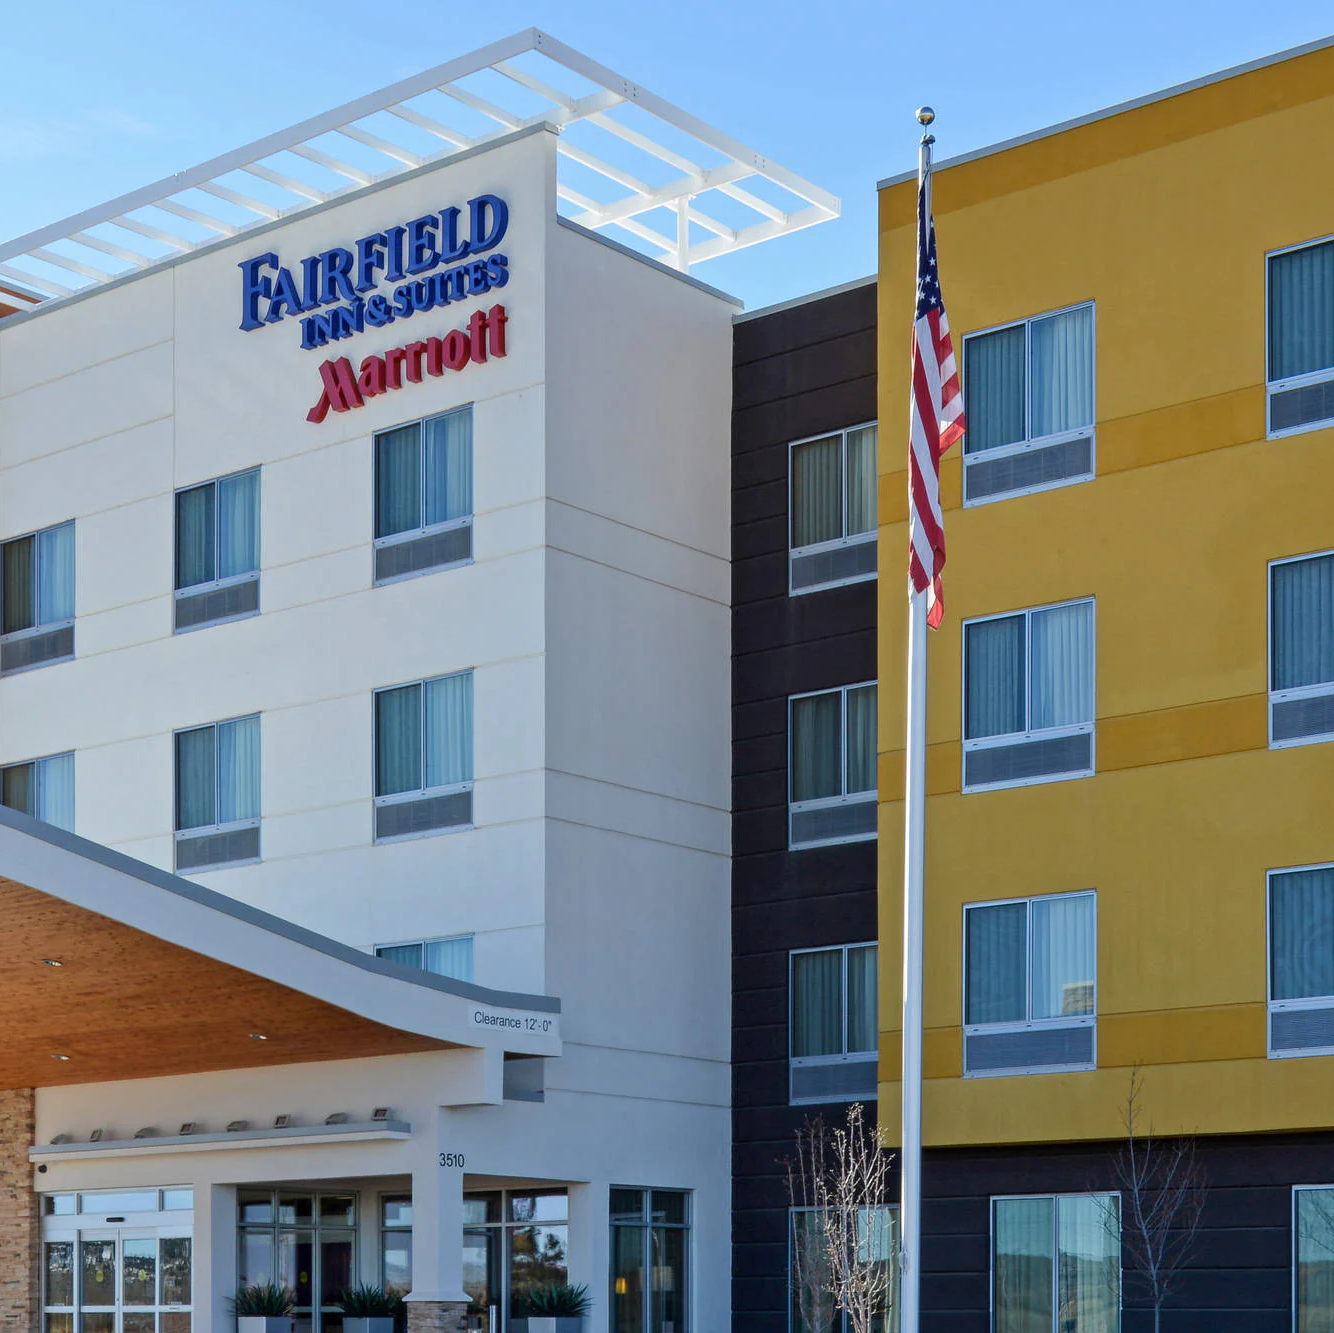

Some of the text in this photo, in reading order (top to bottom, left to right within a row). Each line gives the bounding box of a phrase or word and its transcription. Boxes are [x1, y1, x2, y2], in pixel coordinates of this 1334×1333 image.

[238, 194, 509, 332] FAIRFIELD
[305, 303, 509, 424] Marriott
[474, 1011, 521, 1029] Clearance
[439, 1152, 465, 1168] 3510
